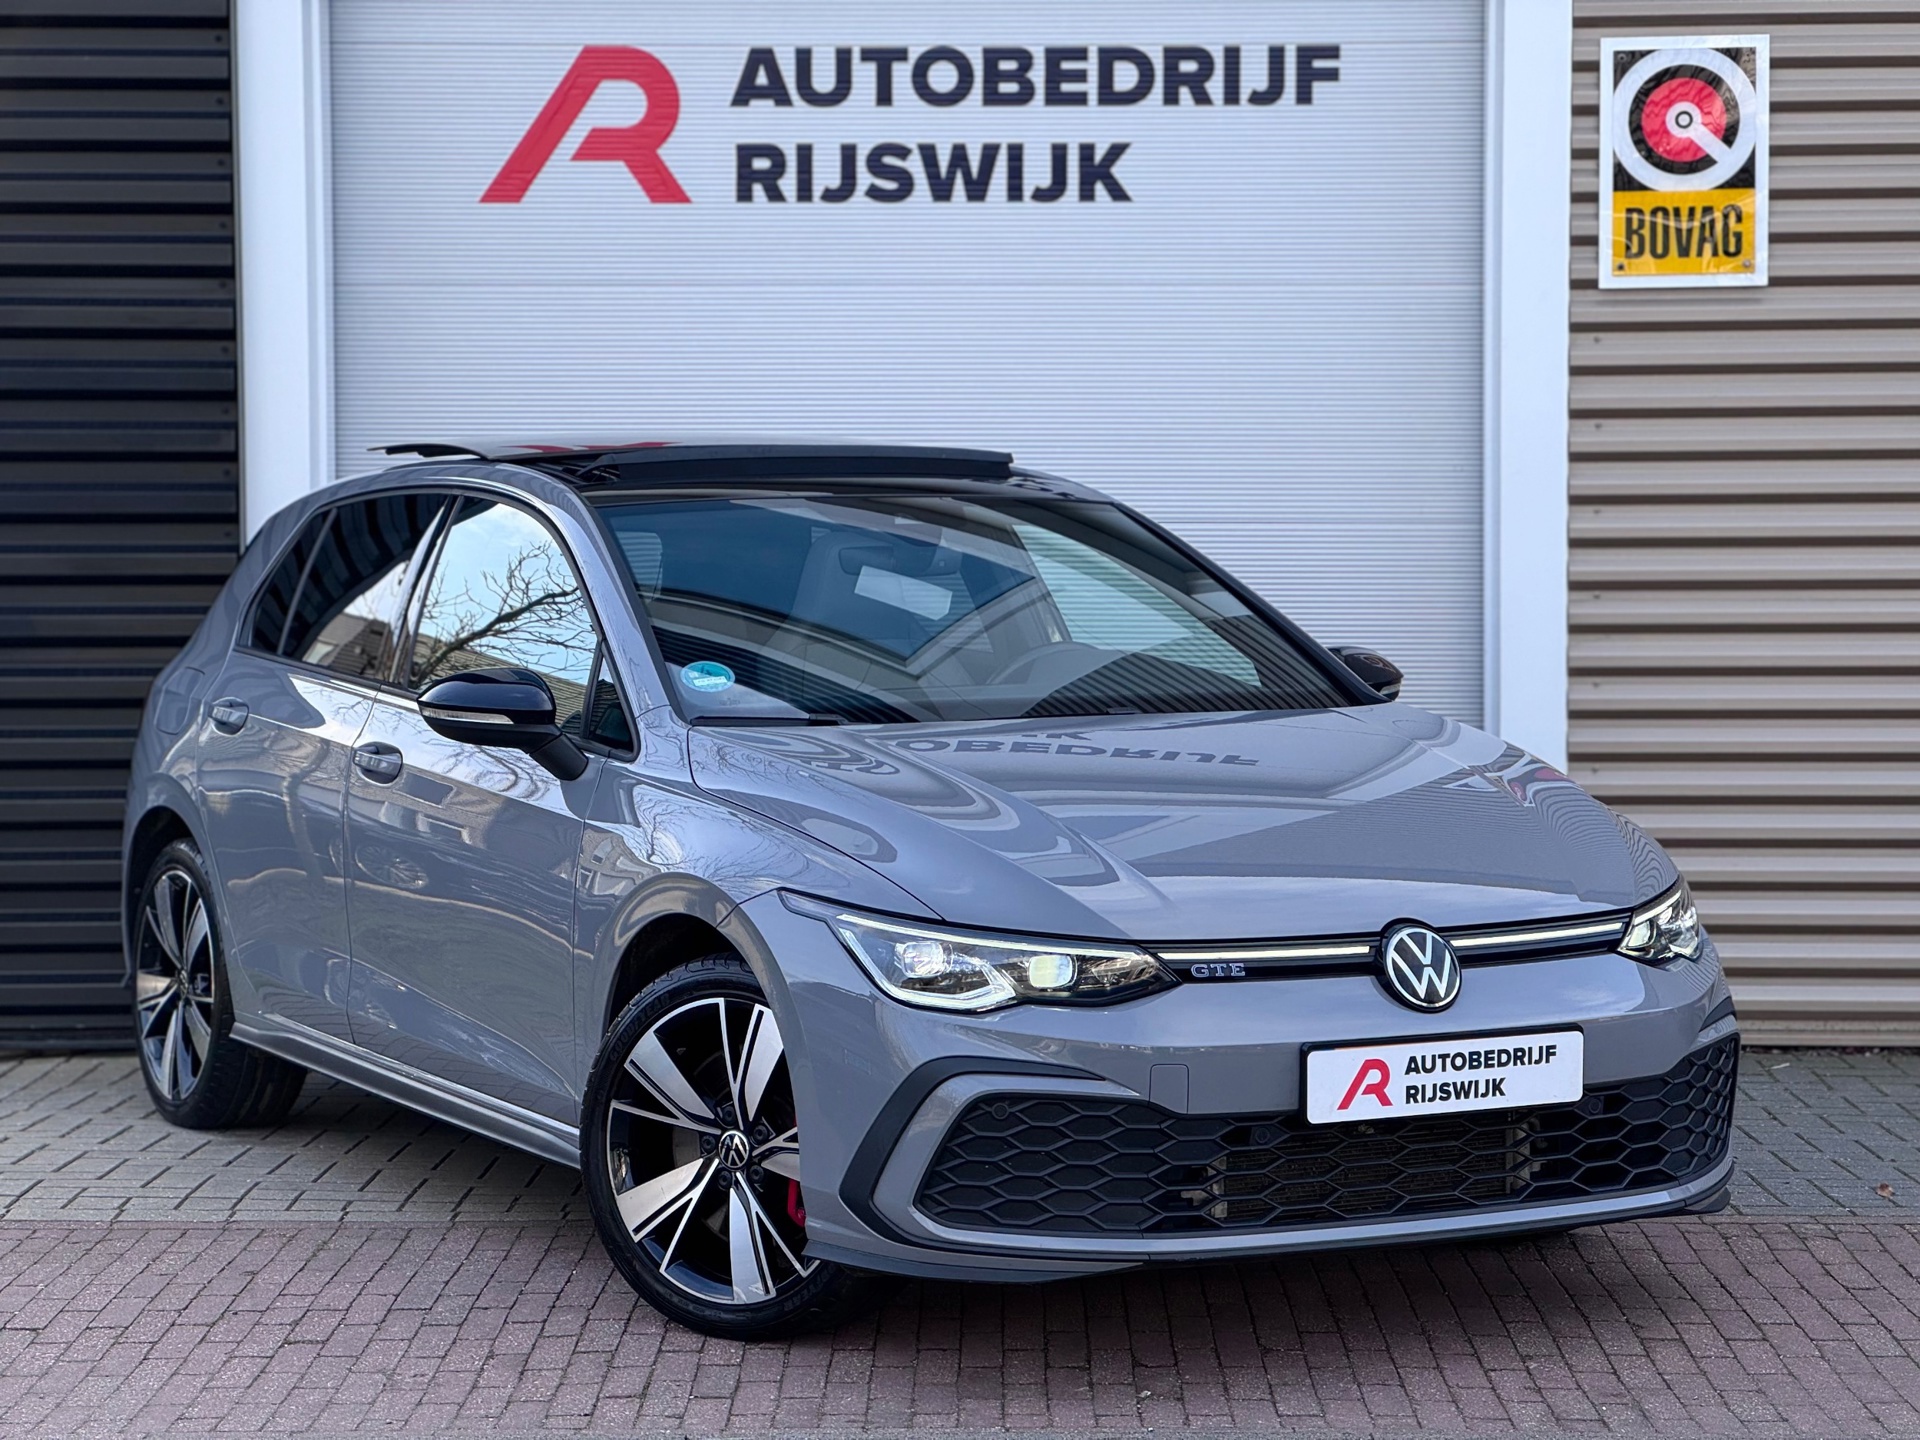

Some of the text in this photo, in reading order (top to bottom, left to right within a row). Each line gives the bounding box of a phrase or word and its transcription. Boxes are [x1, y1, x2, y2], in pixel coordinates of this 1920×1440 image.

[730, 46, 1341, 107] AUTOBEDRIJF
[736, 142, 1133, 203] RIJSWIJK
[1624, 204, 1743, 260] BOVAG
[1190, 962, 1246, 978] GTE
[1404, 1044, 1557, 1076] AUTOBEDRIJF
[1404, 1077, 1507, 1105] RIJSWIJK
